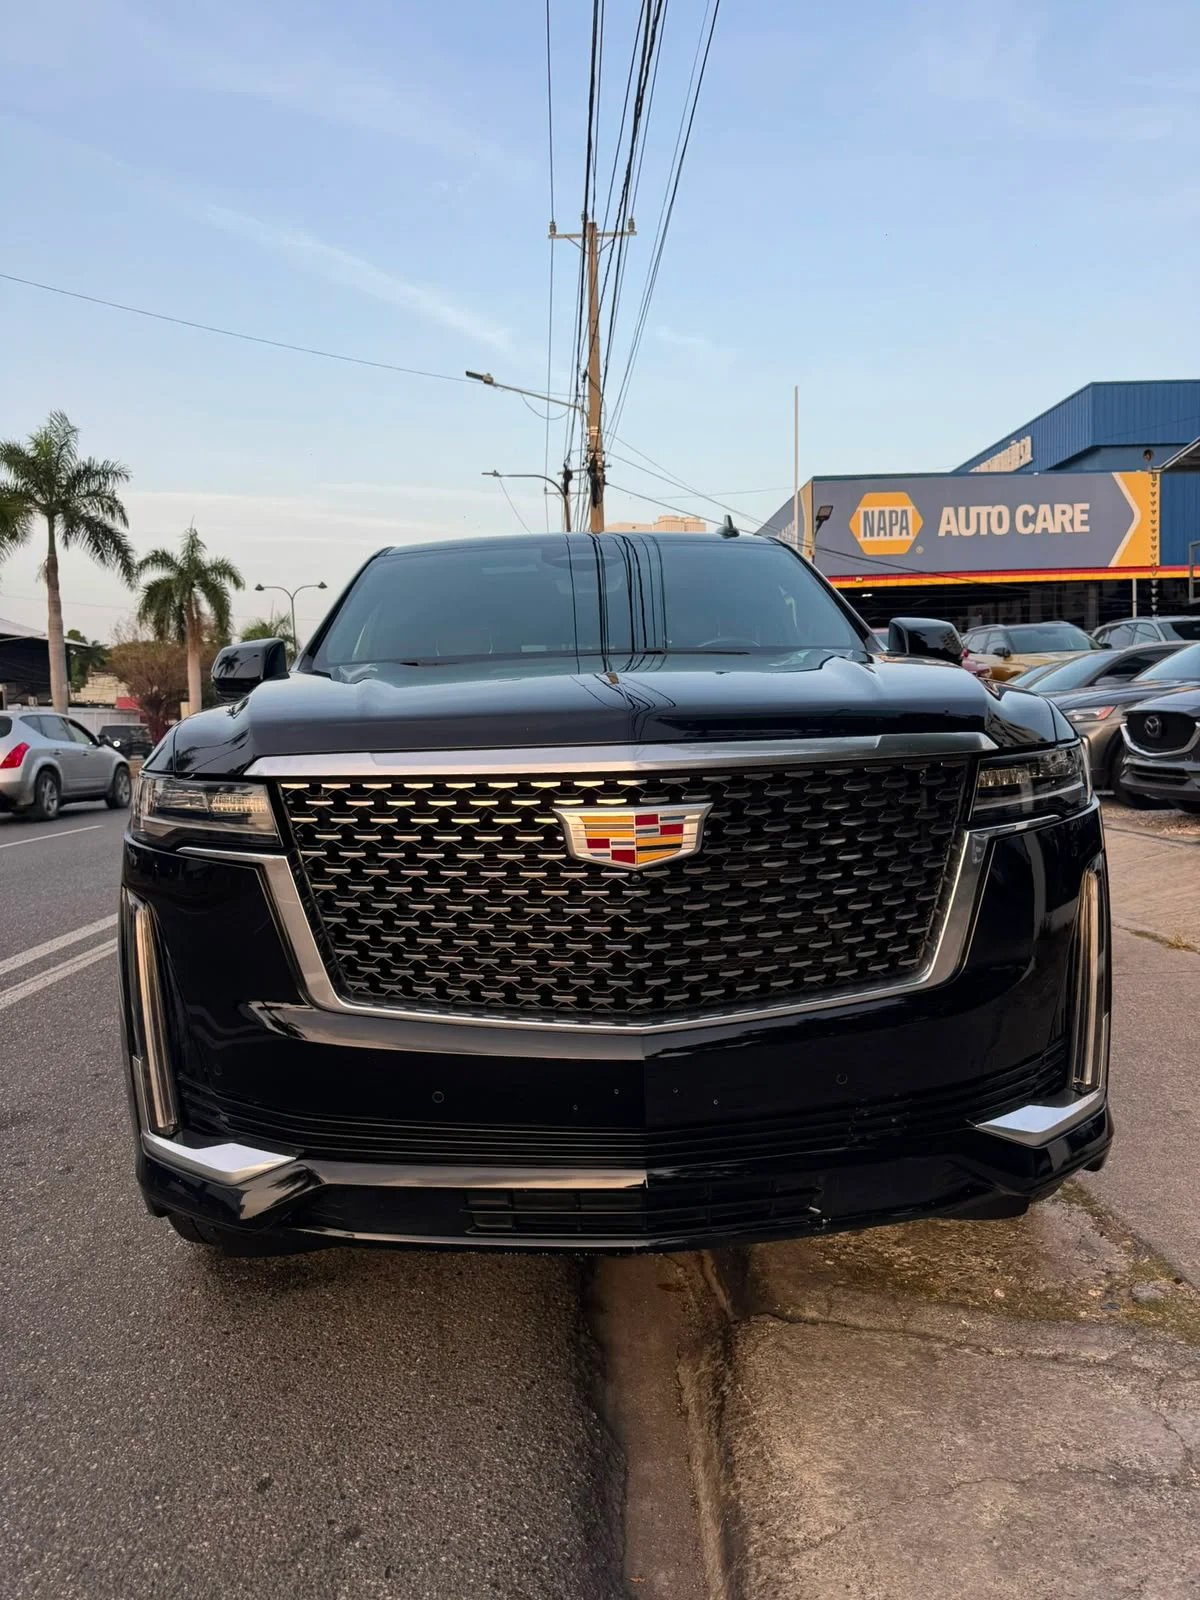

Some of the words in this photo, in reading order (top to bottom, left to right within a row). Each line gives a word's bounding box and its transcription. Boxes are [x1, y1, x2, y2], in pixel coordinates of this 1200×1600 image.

[863, 509, 910, 538] NAPA
[938, 505, 1010, 537] AUTO
[1015, 503, 1090, 534] CARE
